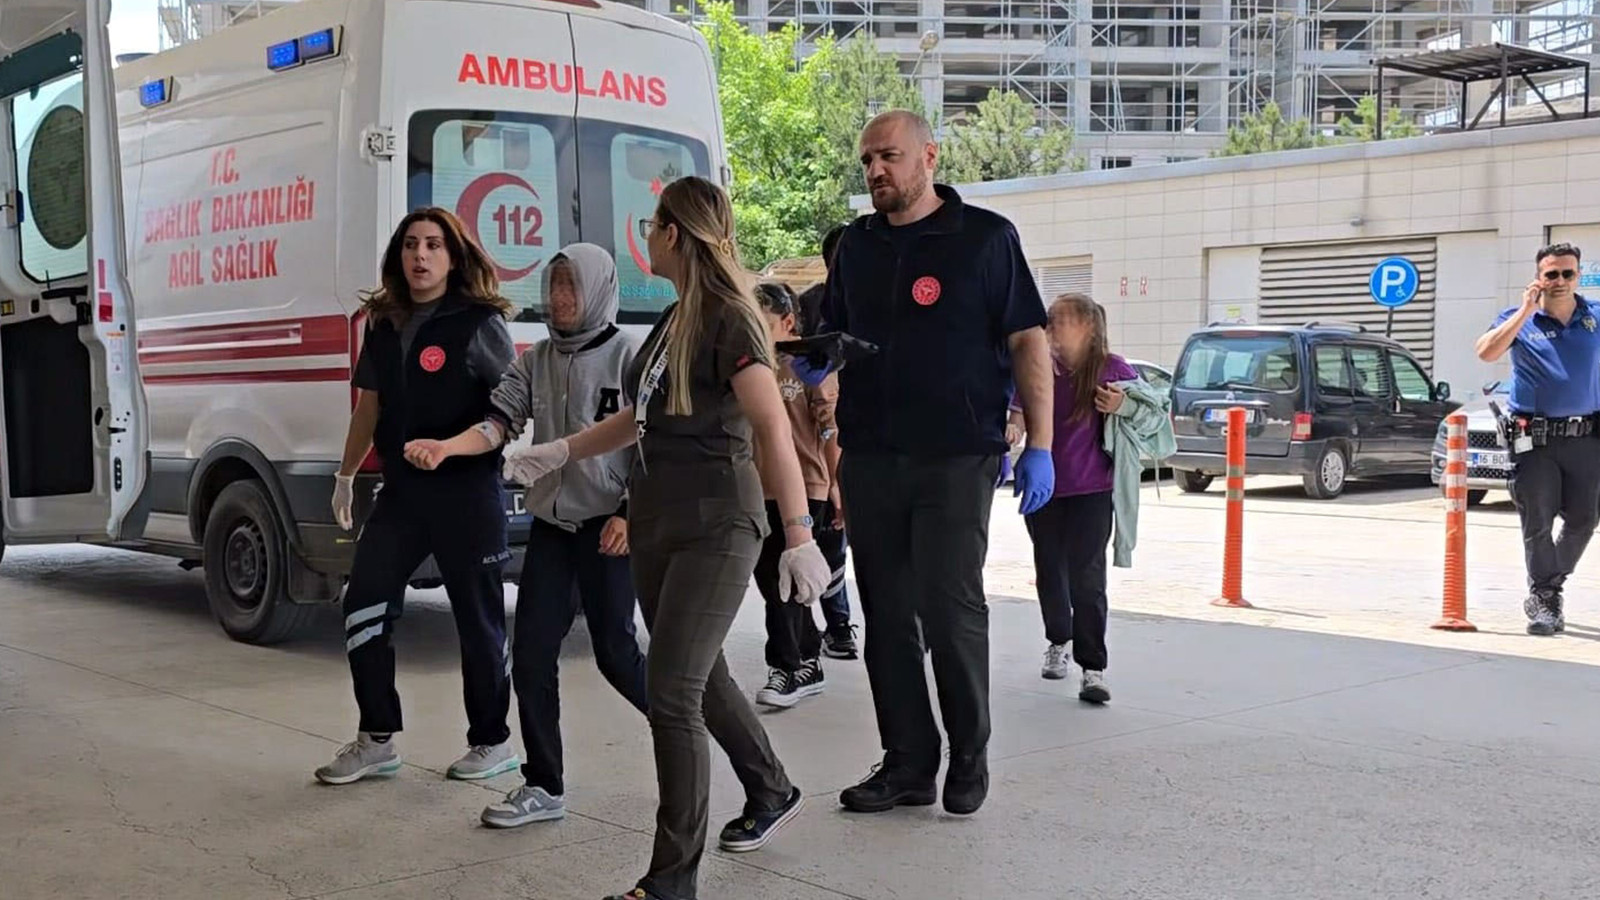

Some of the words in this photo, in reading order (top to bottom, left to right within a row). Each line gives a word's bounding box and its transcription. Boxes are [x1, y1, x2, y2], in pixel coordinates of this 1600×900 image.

[458, 53, 667, 107] AMBULANS
[211, 175, 315, 233] BAKANLIĞI
[492, 204, 544, 247] 112
[168, 243, 204, 288] ACİL
[212, 234, 279, 283] SAĞLIK
[1380, 265, 1407, 298] P
